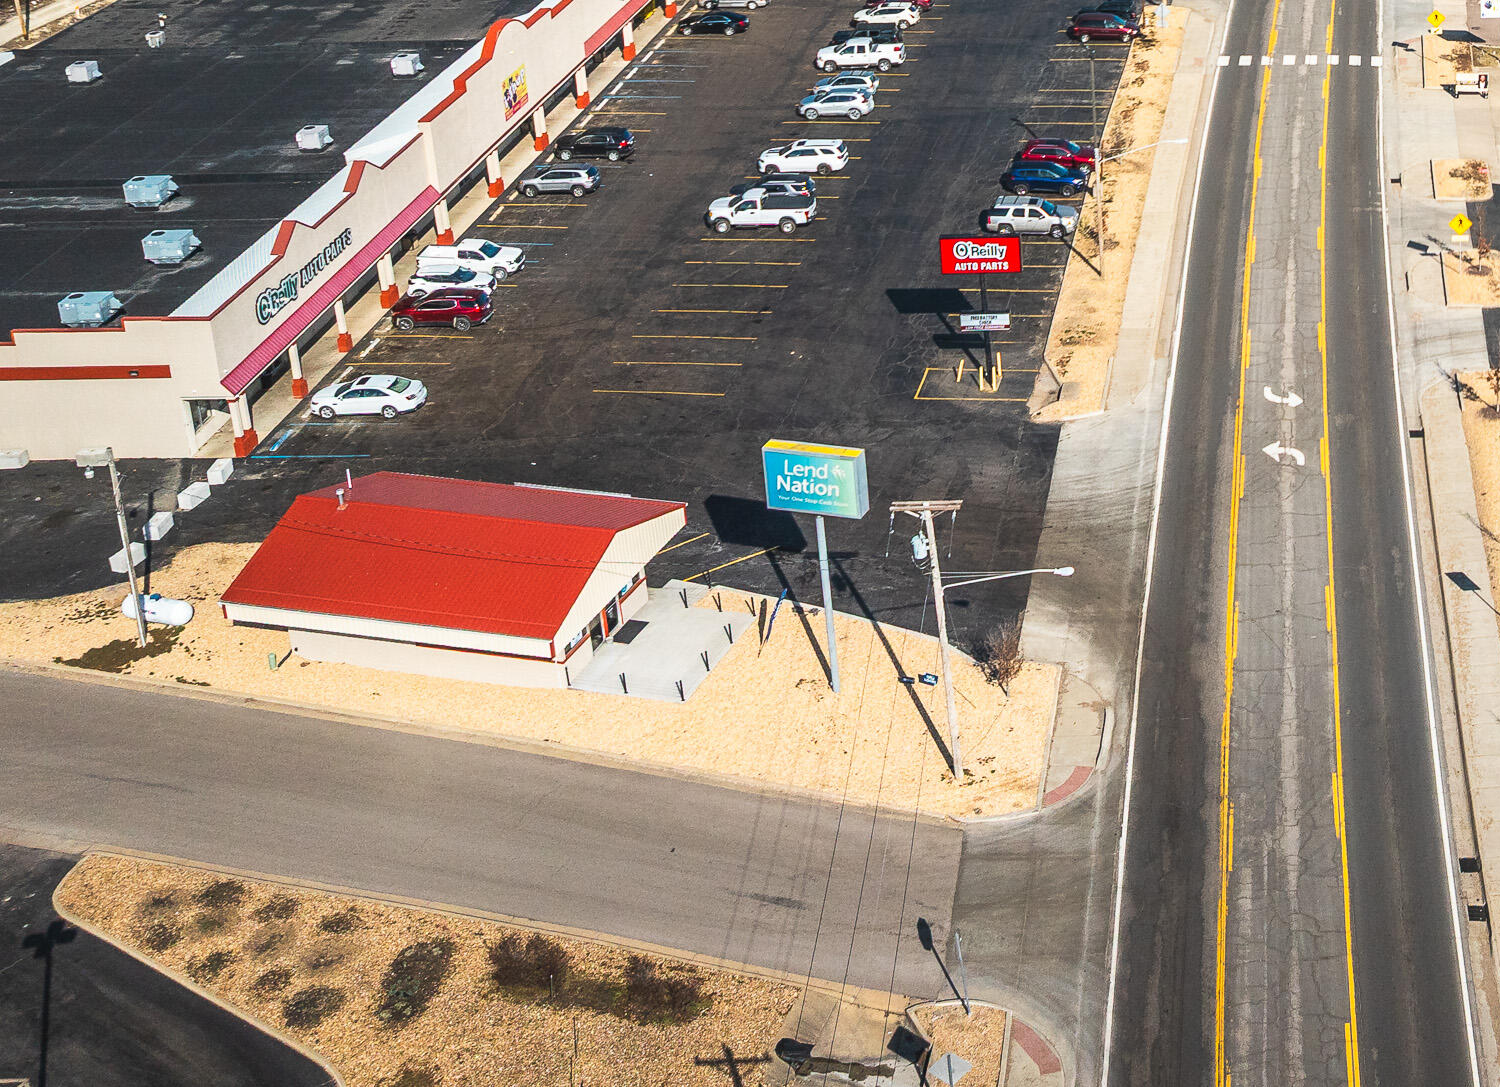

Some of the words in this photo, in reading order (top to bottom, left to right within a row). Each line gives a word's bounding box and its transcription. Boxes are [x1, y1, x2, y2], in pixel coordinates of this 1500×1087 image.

[954, 241, 1006, 259] O'Reilly
[256, 272, 299, 325] O'Reilly
[300, 253, 325, 288] AUTO
[324, 227, 353, 266] PARTS
[954, 262, 979, 271] AUTO
[980, 261, 1009, 271] PARTS
[784, 459, 828, 479] Lend
[776, 474, 840, 497] Nation
